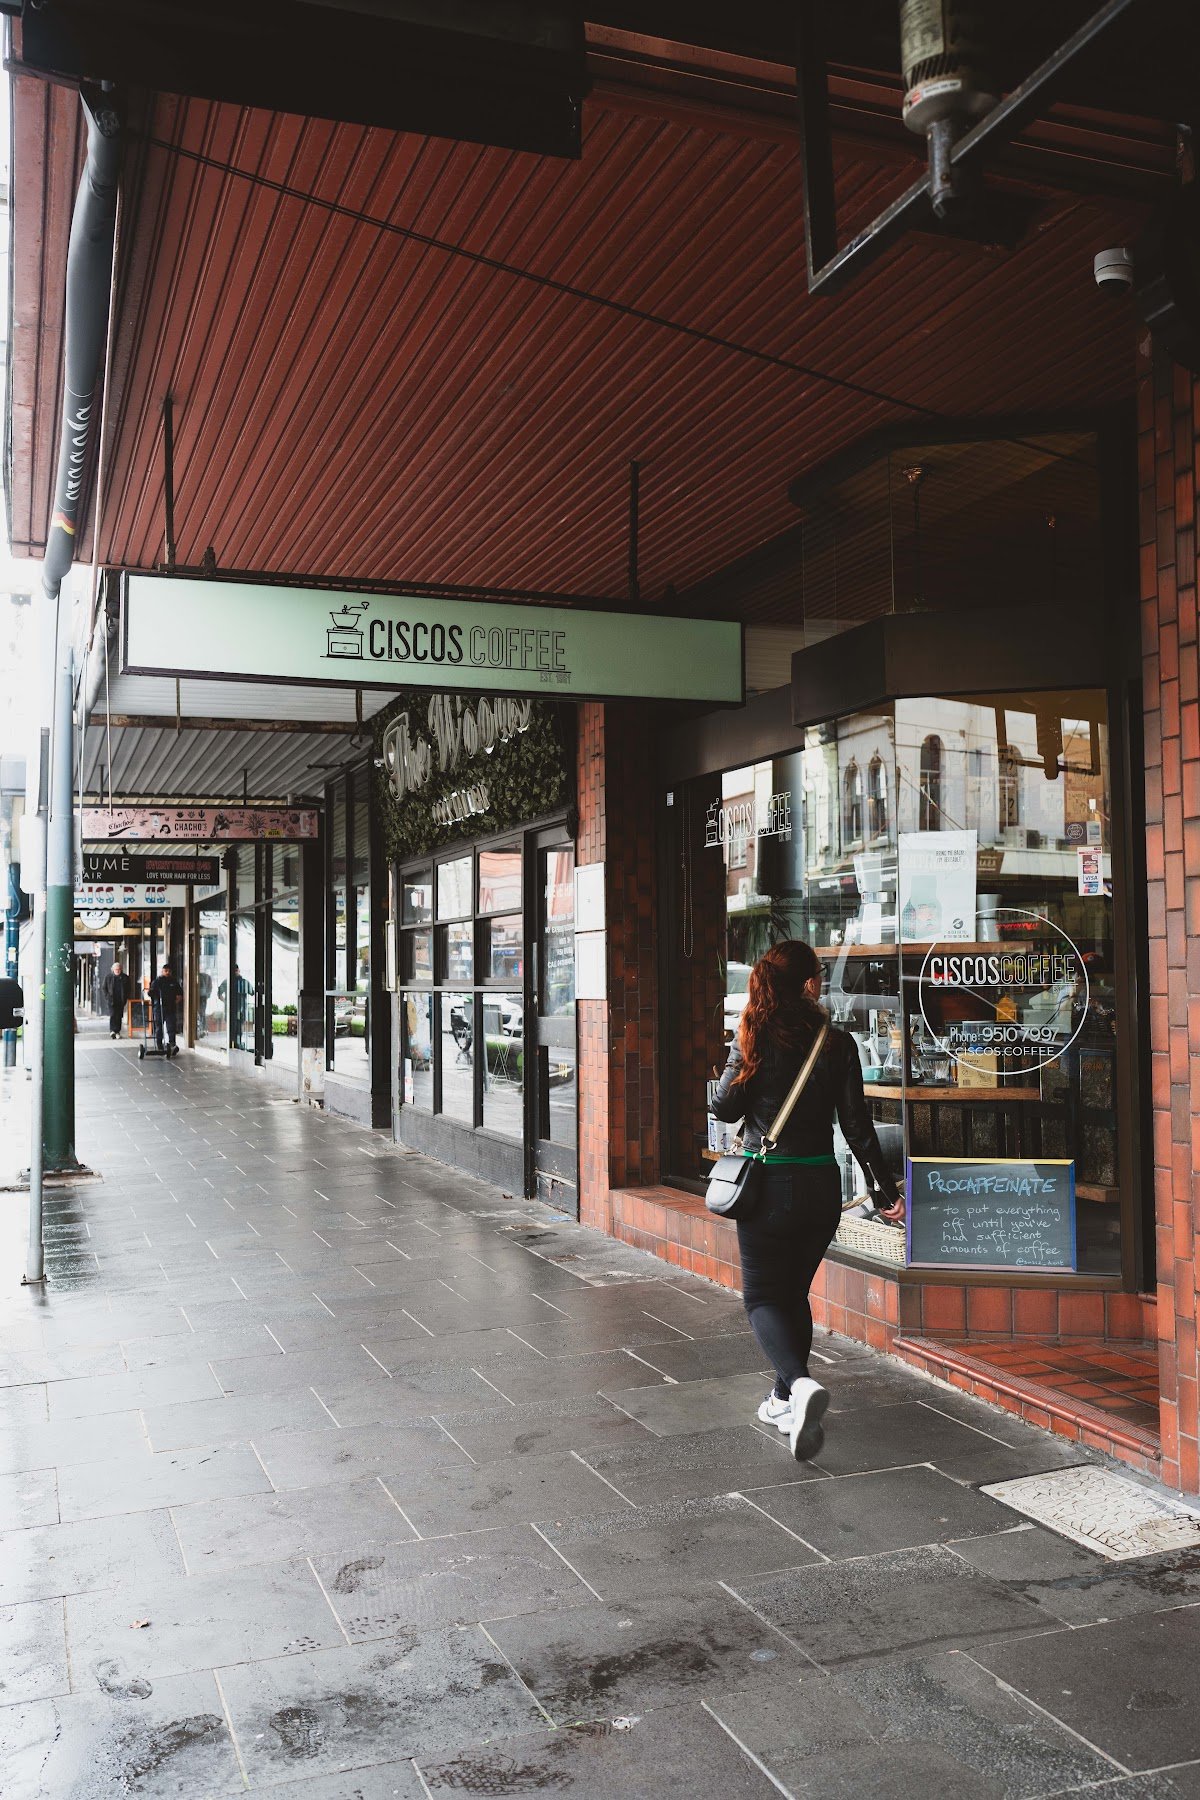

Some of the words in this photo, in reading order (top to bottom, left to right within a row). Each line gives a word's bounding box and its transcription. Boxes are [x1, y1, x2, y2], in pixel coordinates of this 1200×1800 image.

[369, 619, 464, 664] CISCOS
[469, 625, 567, 671] COFFEE
[718, 800, 754, 842] CISCOS
[752, 791, 792, 836] CFFEE
[83, 857, 130, 871] UME
[82, 871, 103, 880] AIR
[146, 872, 159, 880] LOVE
[160, 872, 174, 880] YOUR
[174, 872, 187, 880] HAIR
[145, 886, 166, 904] US
[930, 956, 1000, 986] CISCOS
[1000, 954, 1076, 984] COFFEE
[982, 1027, 1018, 1042] 9510
[1021, 1026, 1060, 1042] 7997
[955, 1046, 1055, 1057] CISCOS.COFFEE
[944, 1205, 960, 1215] to
[967, 1204, 990, 1219] put
[996, 1203, 1060, 1222] everything
[943, 1218, 966, 1234] off
[973, 1217, 1004, 1229] until
[1011, 1219, 1052, 1233] you've
[943, 1231, 969, 1242] had
[977, 1229, 1042, 1245] sufficient
[941, 1244, 989, 1254] amounts
[995, 1241, 1011, 1259] of
[1017, 1240, 1061, 1260] coffee
